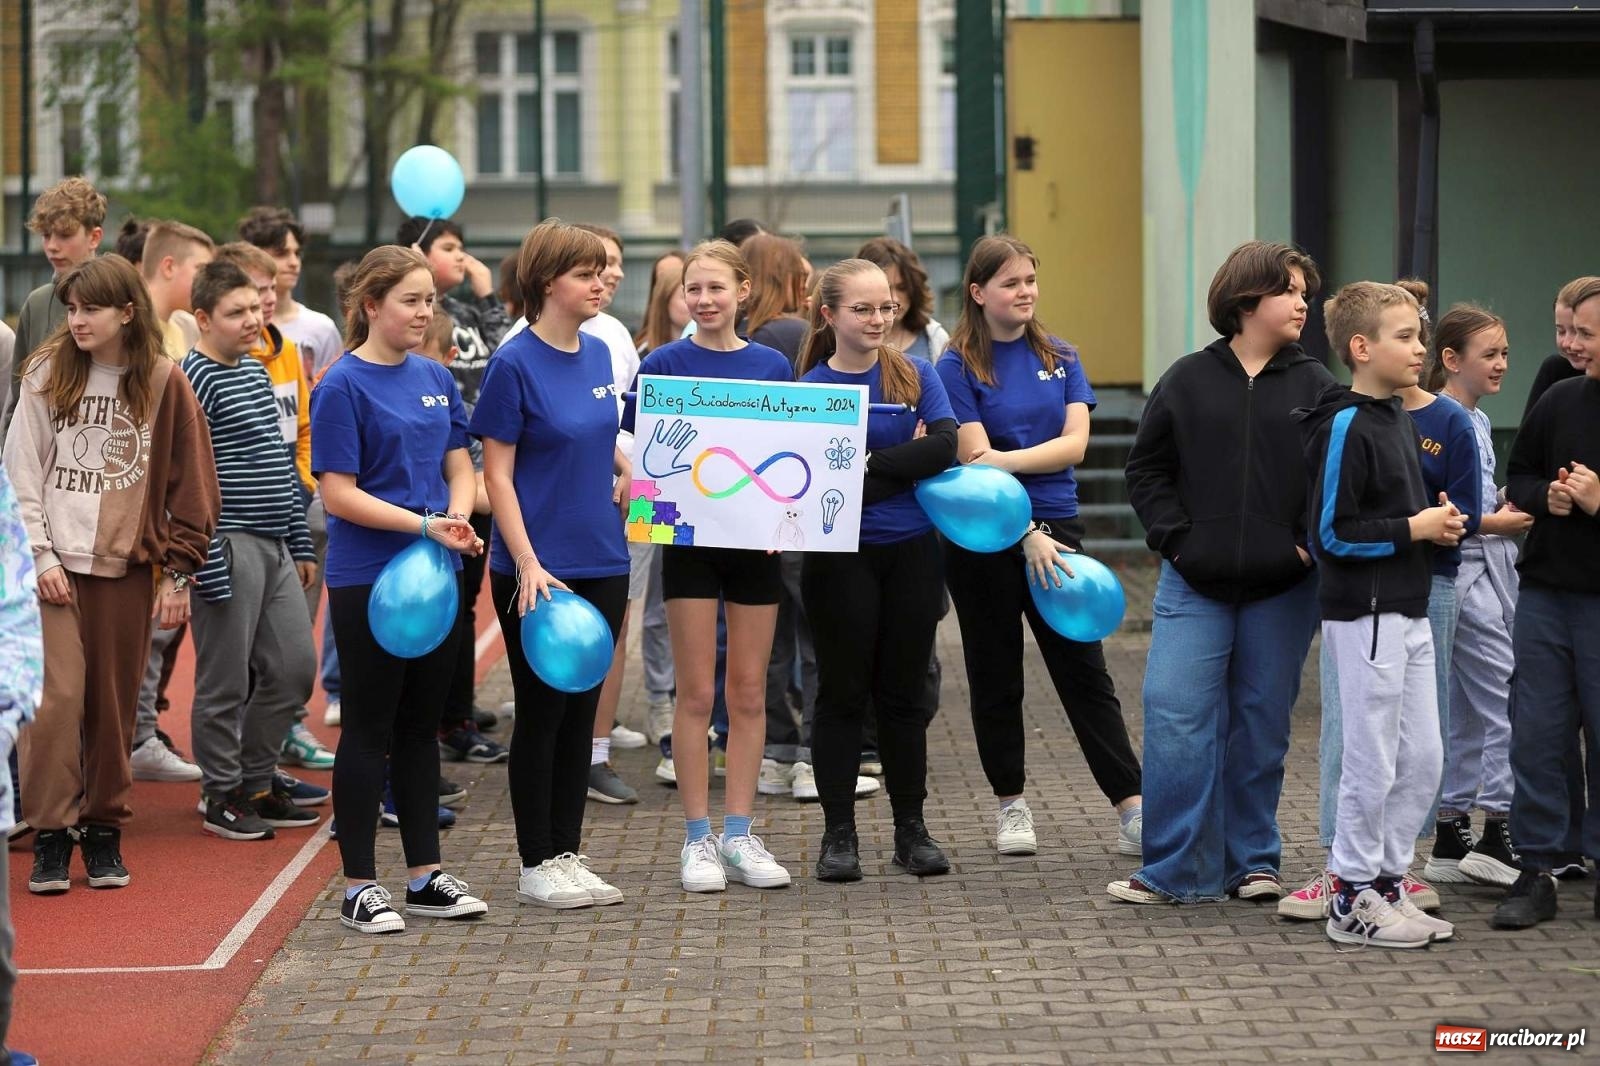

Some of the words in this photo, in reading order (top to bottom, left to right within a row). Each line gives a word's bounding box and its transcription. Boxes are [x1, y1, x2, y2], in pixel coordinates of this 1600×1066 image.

[421, 395, 436, 408] SP
[435, 394, 449, 407] 13
[592, 386, 607, 399] SP
[644, 384, 684, 414] Bieg
[687, 381, 760, 408] Świadomości
[760, 394, 817, 419] Autyzmu
[825, 397, 855, 413] 2024
[123, 405, 151, 447] LGUE
[115, 465, 145, 491] GAME
